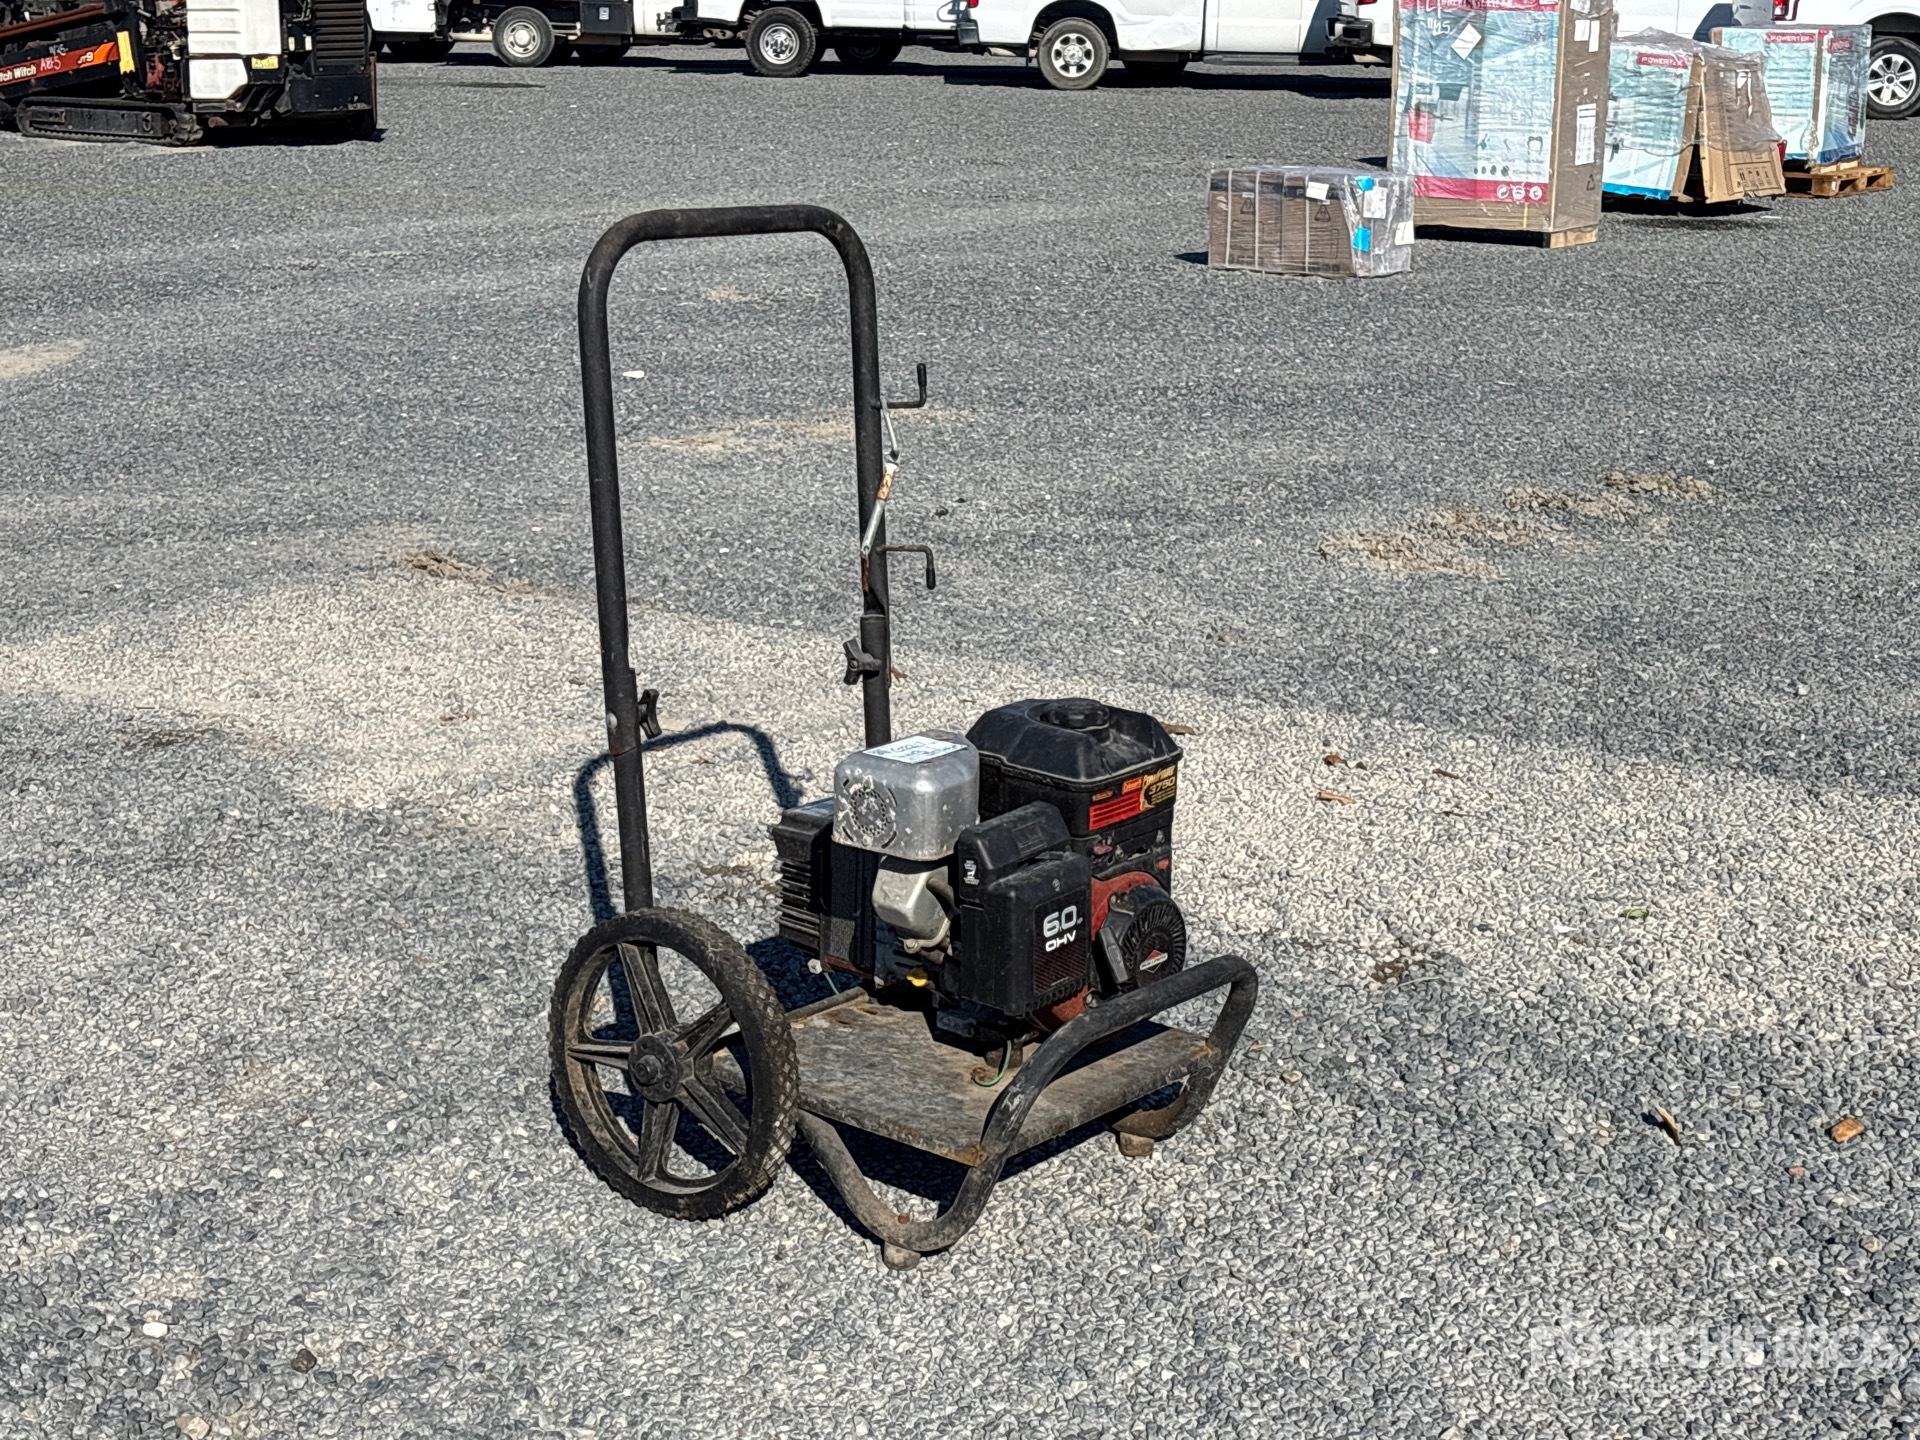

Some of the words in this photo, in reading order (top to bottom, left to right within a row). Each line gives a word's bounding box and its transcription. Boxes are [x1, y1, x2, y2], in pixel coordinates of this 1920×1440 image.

[14, 66, 36, 78] Witch
[1149, 776, 1175, 795] 3750
[1043, 905, 1077, 938] 6.0
[1045, 930, 1076, 952] OHV
